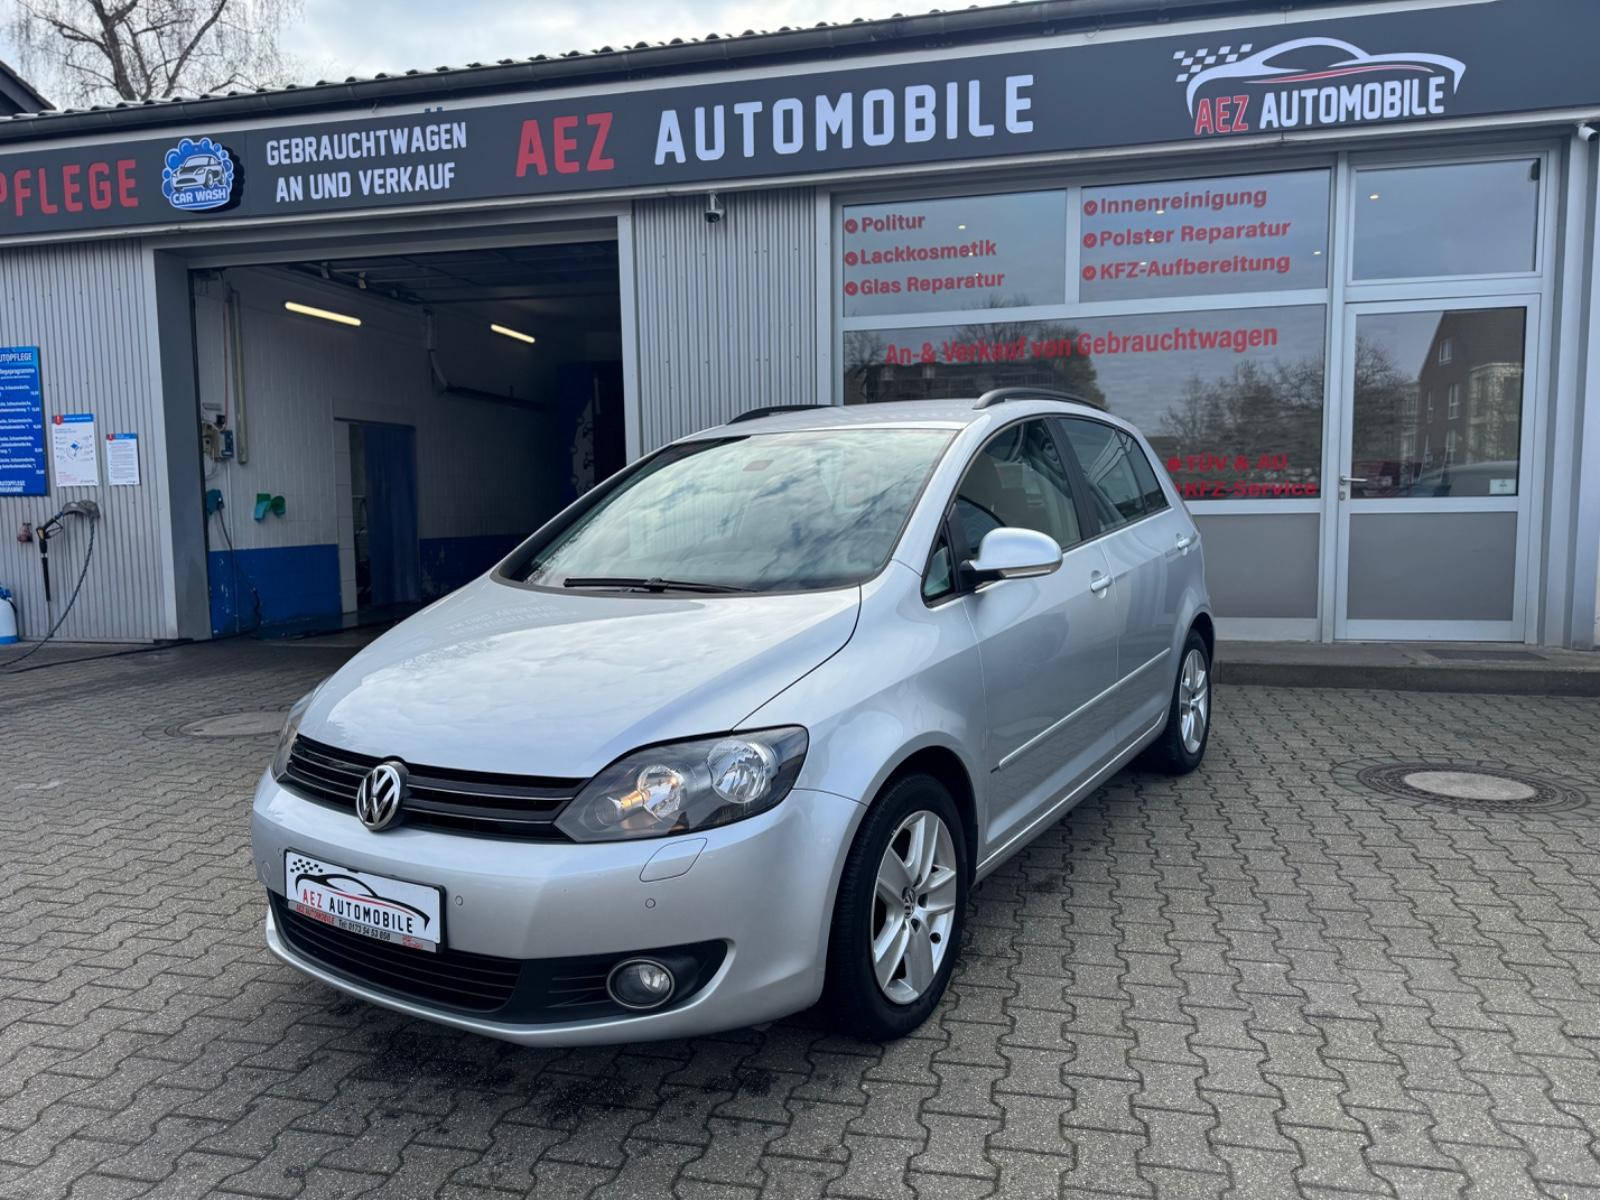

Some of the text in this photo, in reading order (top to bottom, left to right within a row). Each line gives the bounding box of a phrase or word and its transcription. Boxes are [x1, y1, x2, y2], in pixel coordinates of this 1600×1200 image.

[1194, 76, 1446, 136] AEZ AUTOMOBILE
[515, 74, 1035, 178] AEZ AUTOMOBILE
[172, 188, 227, 205] CAR WASH
[276, 162, 455, 203] AN UND VERKAUF
[1101, 188, 1268, 216] Innenreinigung
[861, 214, 926, 232] Politur
[1101, 219, 1292, 247] Polster Reparatur
[860, 240, 997, 265] Lackkosmetik
[1101, 253, 1291, 281] KFZ-Aufbereitung
[860, 271, 1005, 295] Glas Reparatur
[943, 335, 1026, 362] Verkauf
[1030, 338, 1072, 358] von
[1076, 326, 1279, 356] Gebrauchtwagen
[1186, 452, 1288, 472] TÜV & AU
[1184, 481, 1317, 497] KFZ-Service
[303, 888, 413, 933] AEZ AUTOMOBILE
